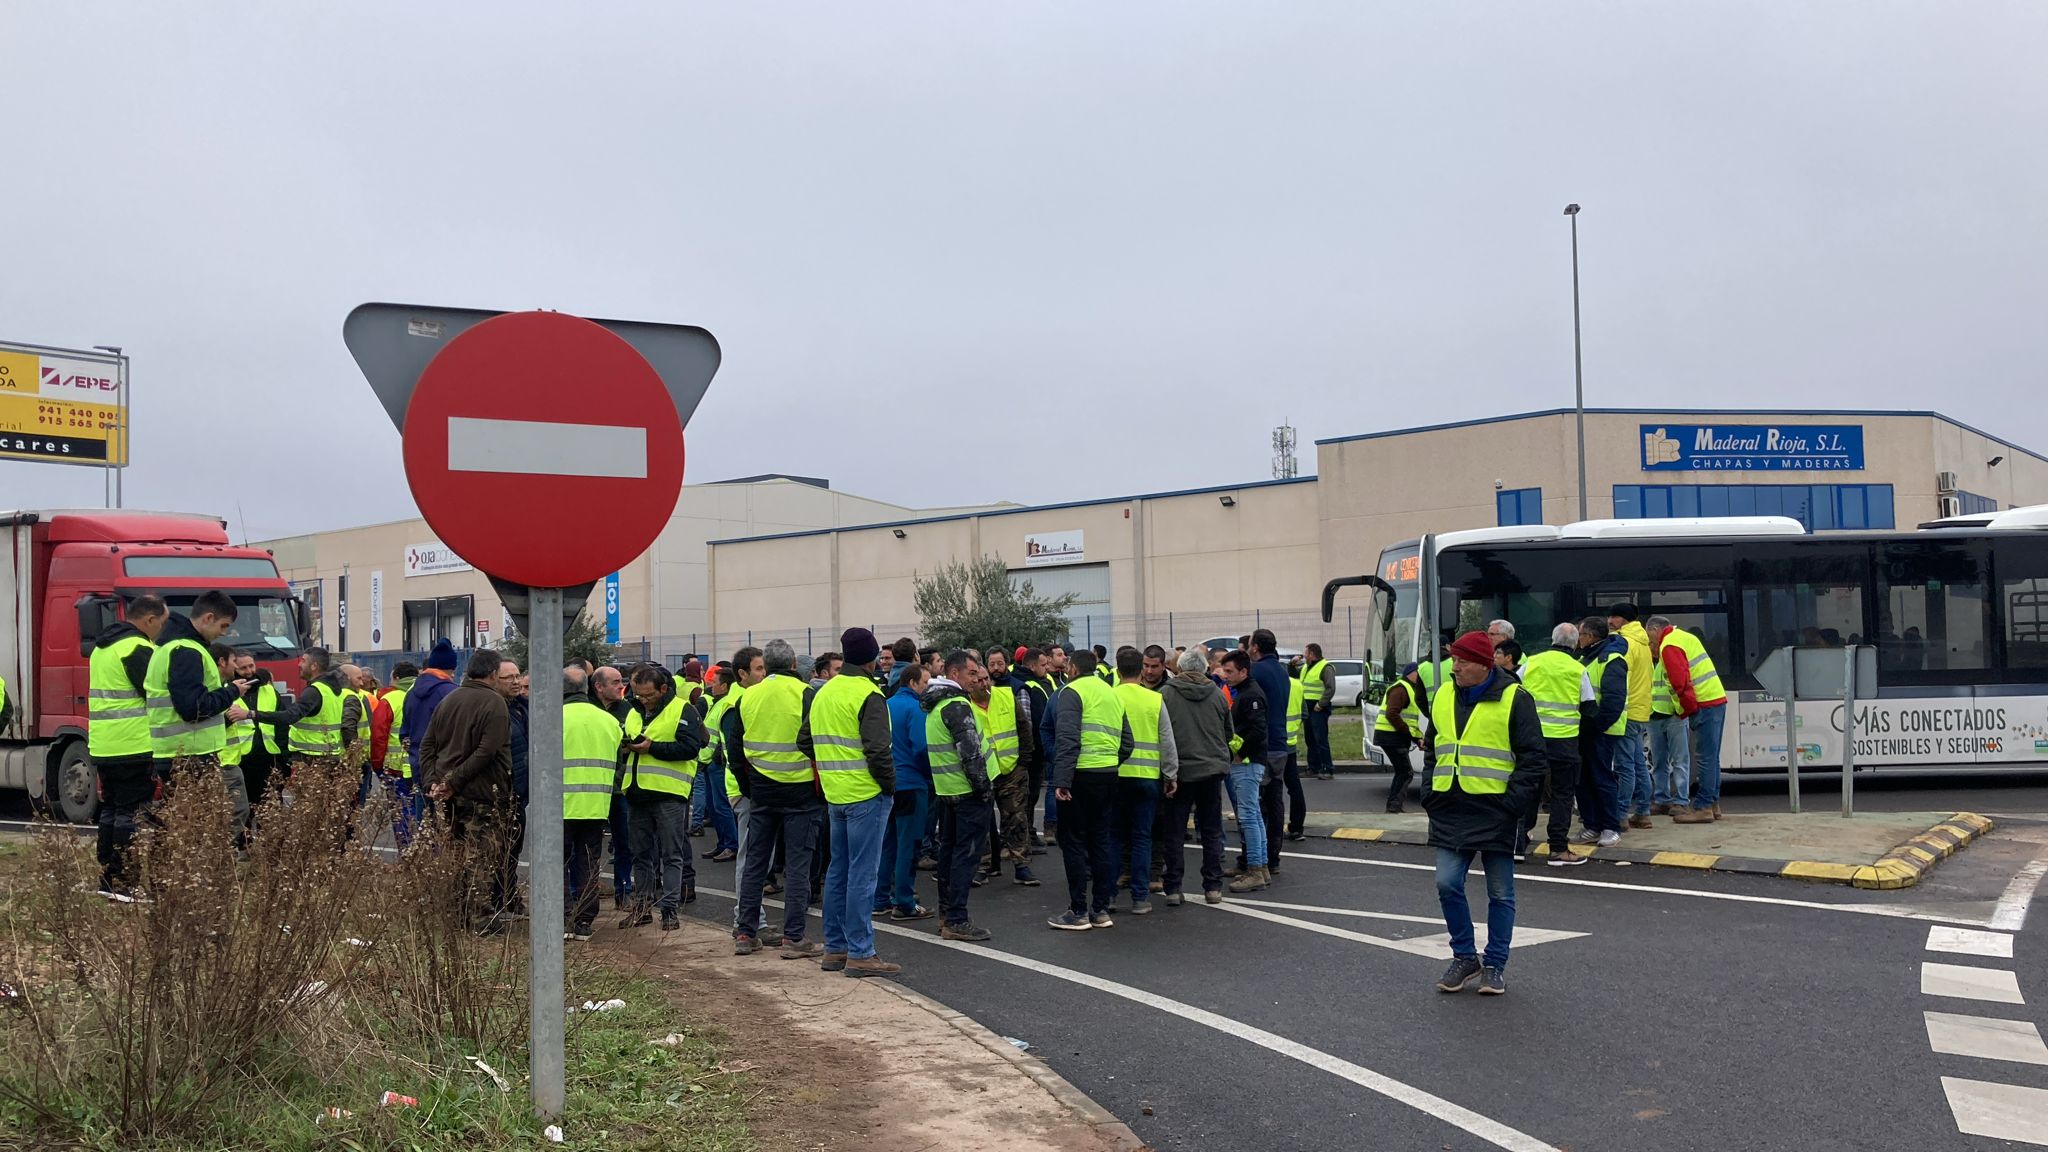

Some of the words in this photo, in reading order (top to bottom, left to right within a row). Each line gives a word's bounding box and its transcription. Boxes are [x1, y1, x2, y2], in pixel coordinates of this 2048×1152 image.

[39, 405, 62, 415] 941
[69, 408, 93, 418] 440
[39, 416, 62, 426] 915
[69, 418, 93, 428] 565
[1694, 428, 1760, 451] Maderal
[1766, 428, 1810, 454] Rioja,
[1815, 434, 1846, 451] S.L.
[1692, 459, 1752, 469] CHAPAS
[1763, 459, 1770, 468] Y
[1781, 459, 1851, 469] MADERAS
[1900, 708, 2006, 732] CONECTADOS
[1852, 738, 1931, 756] SOSTENIBLES
[1937, 739, 1943, 754] Y
[1949, 737, 2003, 754] SEGUROS
